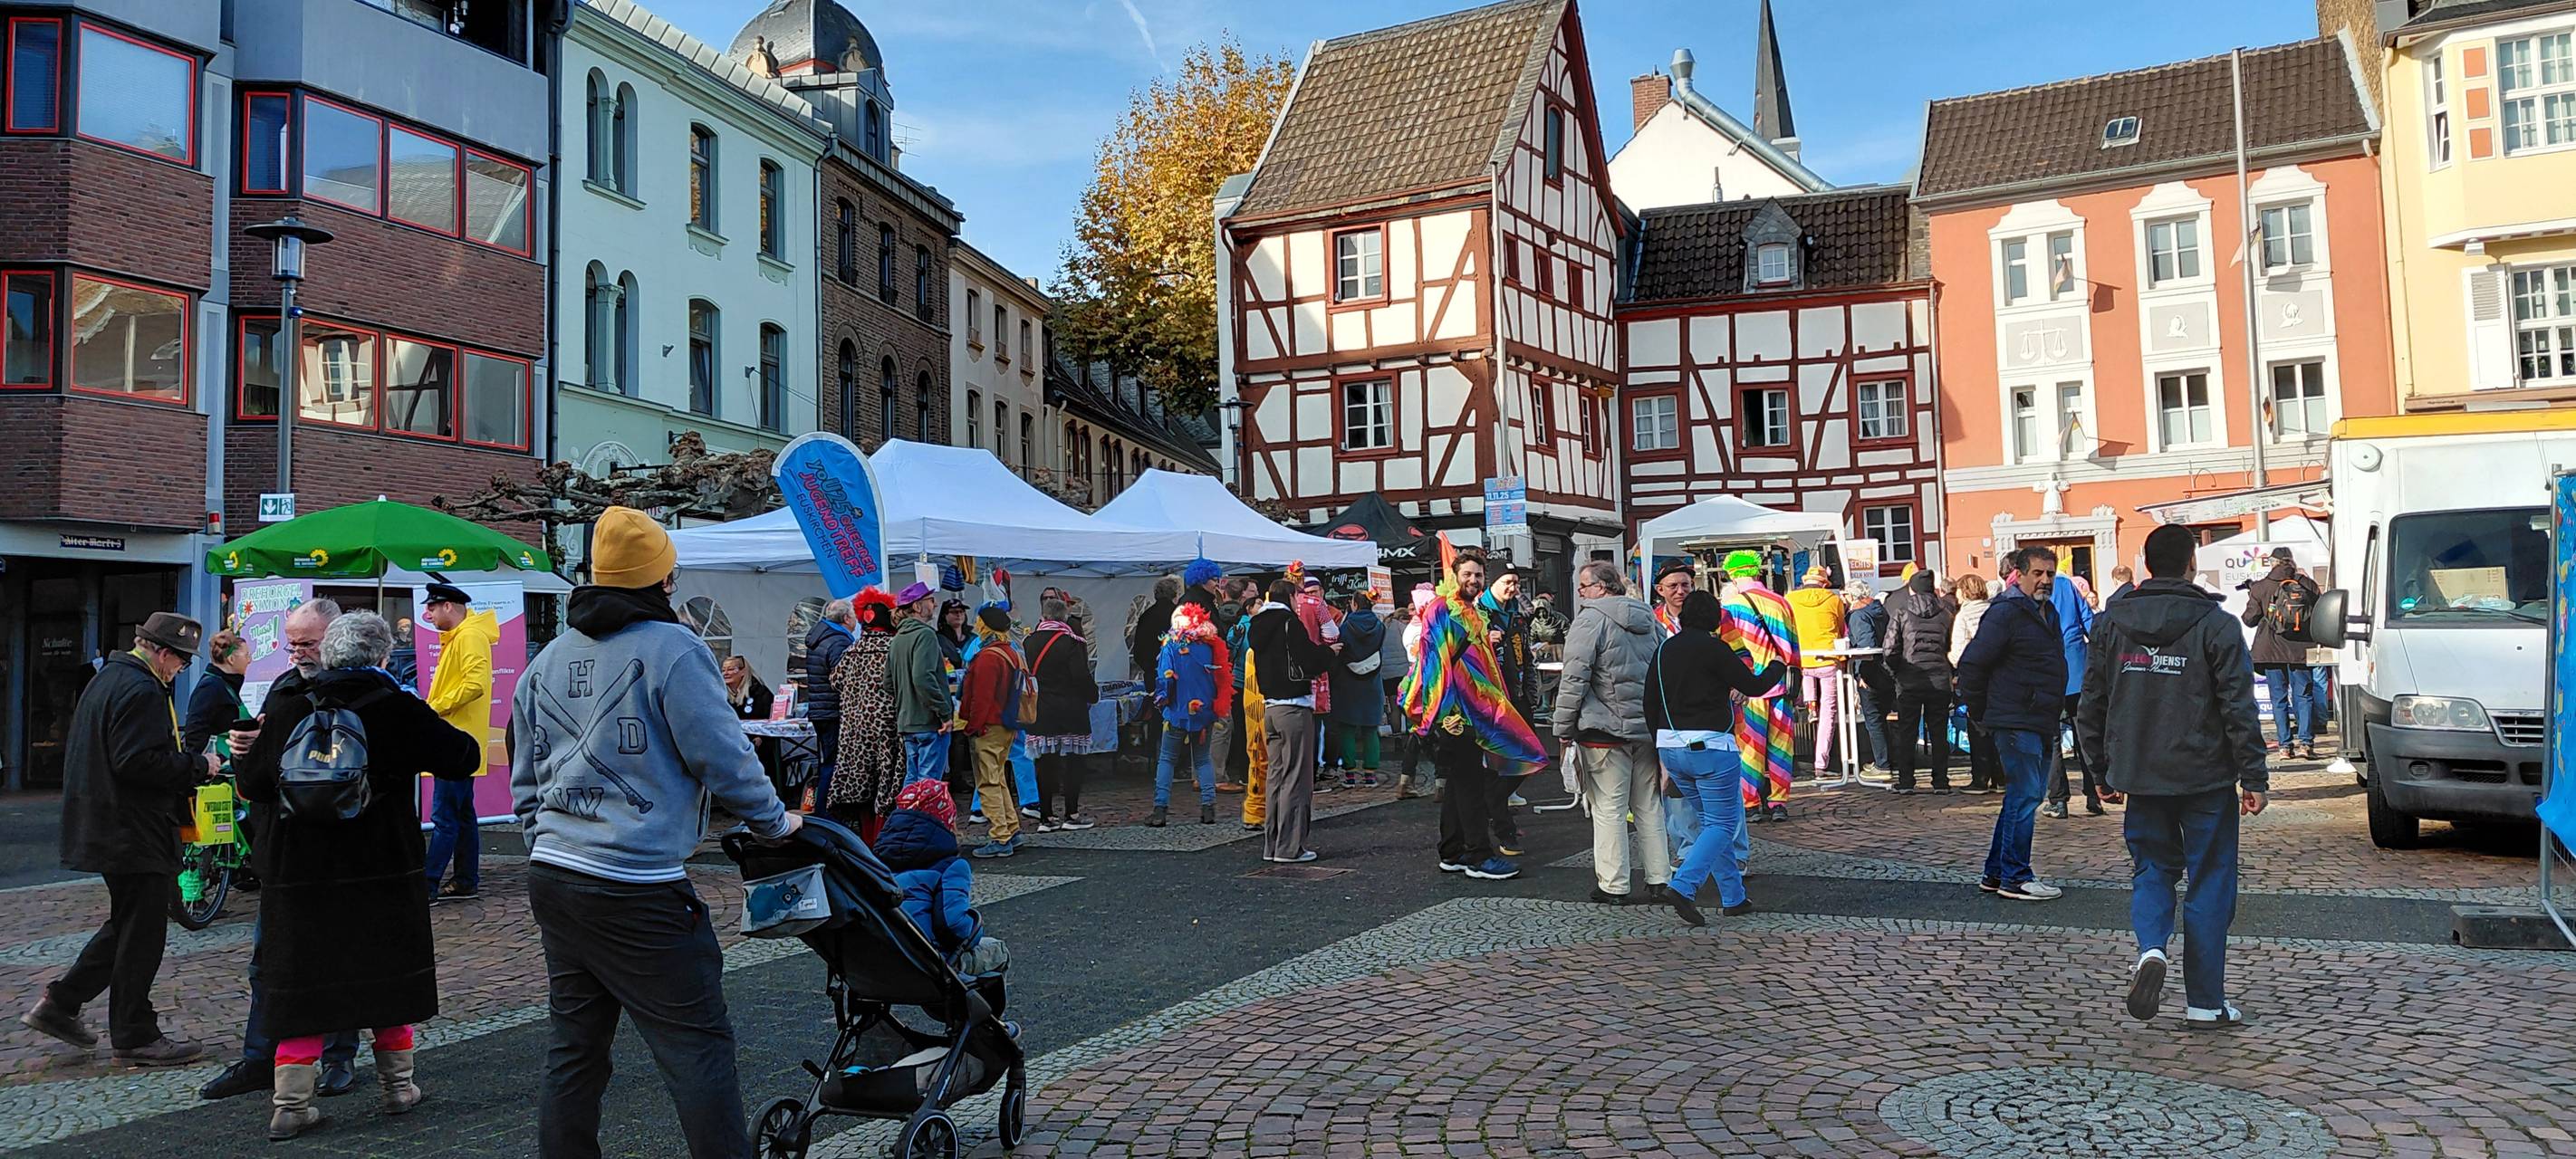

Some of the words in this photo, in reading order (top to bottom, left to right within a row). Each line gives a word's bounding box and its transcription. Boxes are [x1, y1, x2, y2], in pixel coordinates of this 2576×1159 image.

[797, 493, 835, 559] EUSKIRCHEN
[1377, 546, 1416, 559] 4MX
[1850, 560, 1871, 570] ECHTS
[241, 583, 303, 599] DREHORGEL
[1347, 579, 1369, 589] Kun
[255, 597, 288, 611] SIMON
[568, 659, 594, 698] H
[2260, 703, 2273, 712] qu
[617, 716, 648, 755] D
